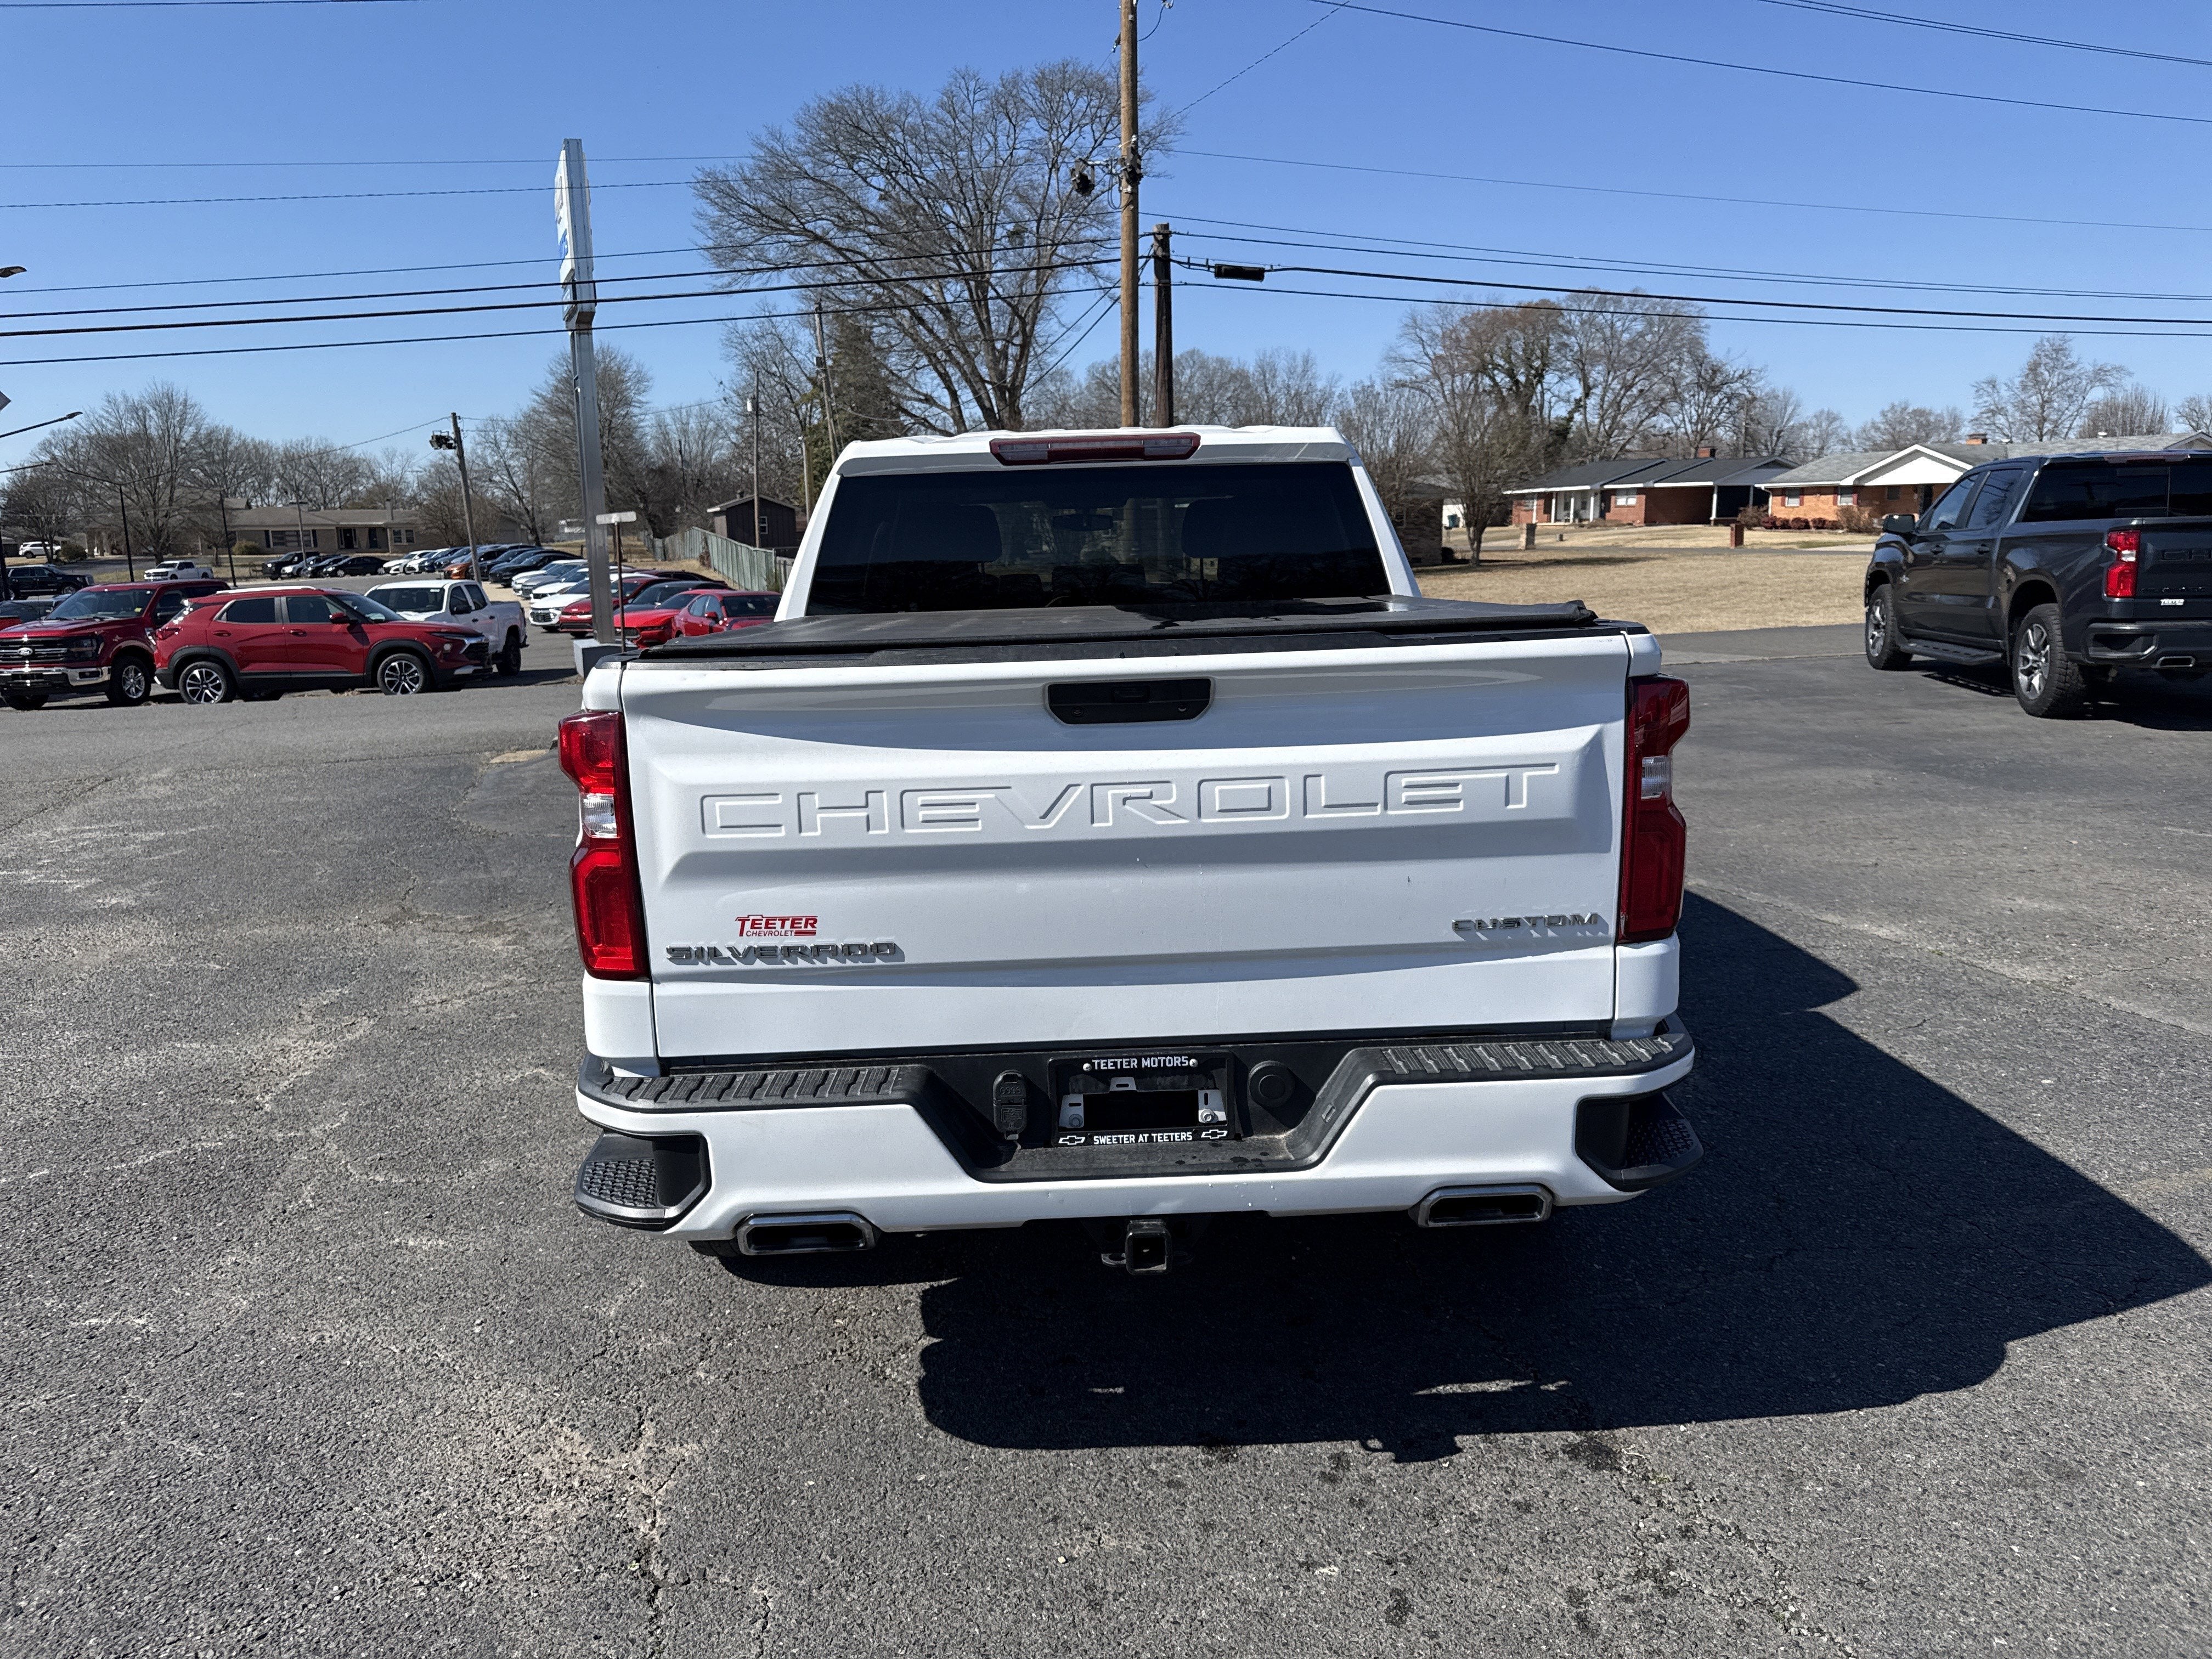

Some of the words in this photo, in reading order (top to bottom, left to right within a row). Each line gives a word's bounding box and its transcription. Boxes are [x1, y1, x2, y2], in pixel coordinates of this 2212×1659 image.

[701, 763, 1559, 838] CHEVROLET
[737, 916, 819, 937] TEETER
[1452, 912, 1599, 932] CUSTOM
[666, 941, 896, 960] SILVERADO
[1092, 1058, 1138, 1070] TEETER
[1142, 1056, 1189, 1068] MOTORS
[1093, 1135, 1136, 1145] SWEETER
[1138, 1134, 1149, 1143] AT
[1151, 1132, 1193, 1143] TEETERS
